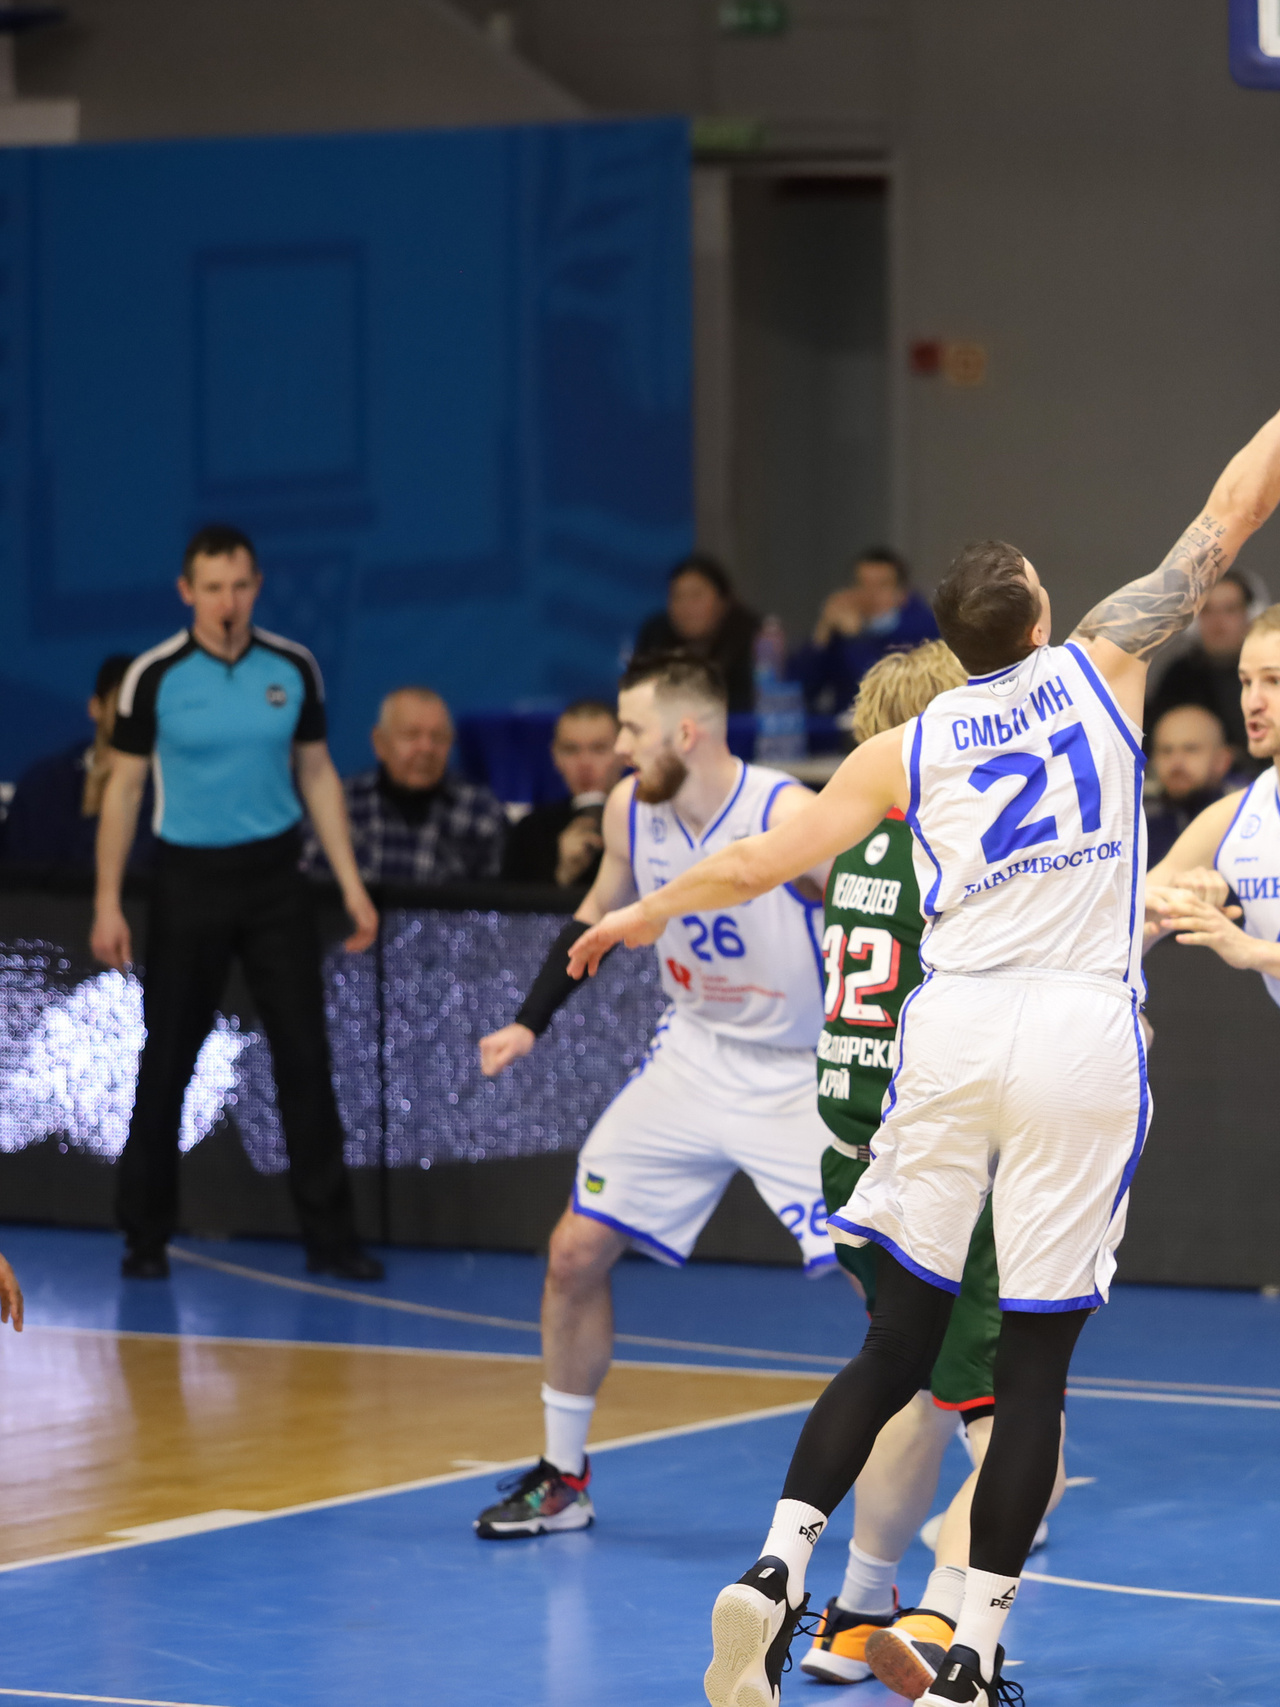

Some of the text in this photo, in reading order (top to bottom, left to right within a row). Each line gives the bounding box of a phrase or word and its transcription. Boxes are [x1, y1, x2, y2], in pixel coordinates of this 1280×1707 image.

[966, 721, 1102, 865] 21
[682, 914, 746, 963] 26
[822, 924, 901, 1027] 32
